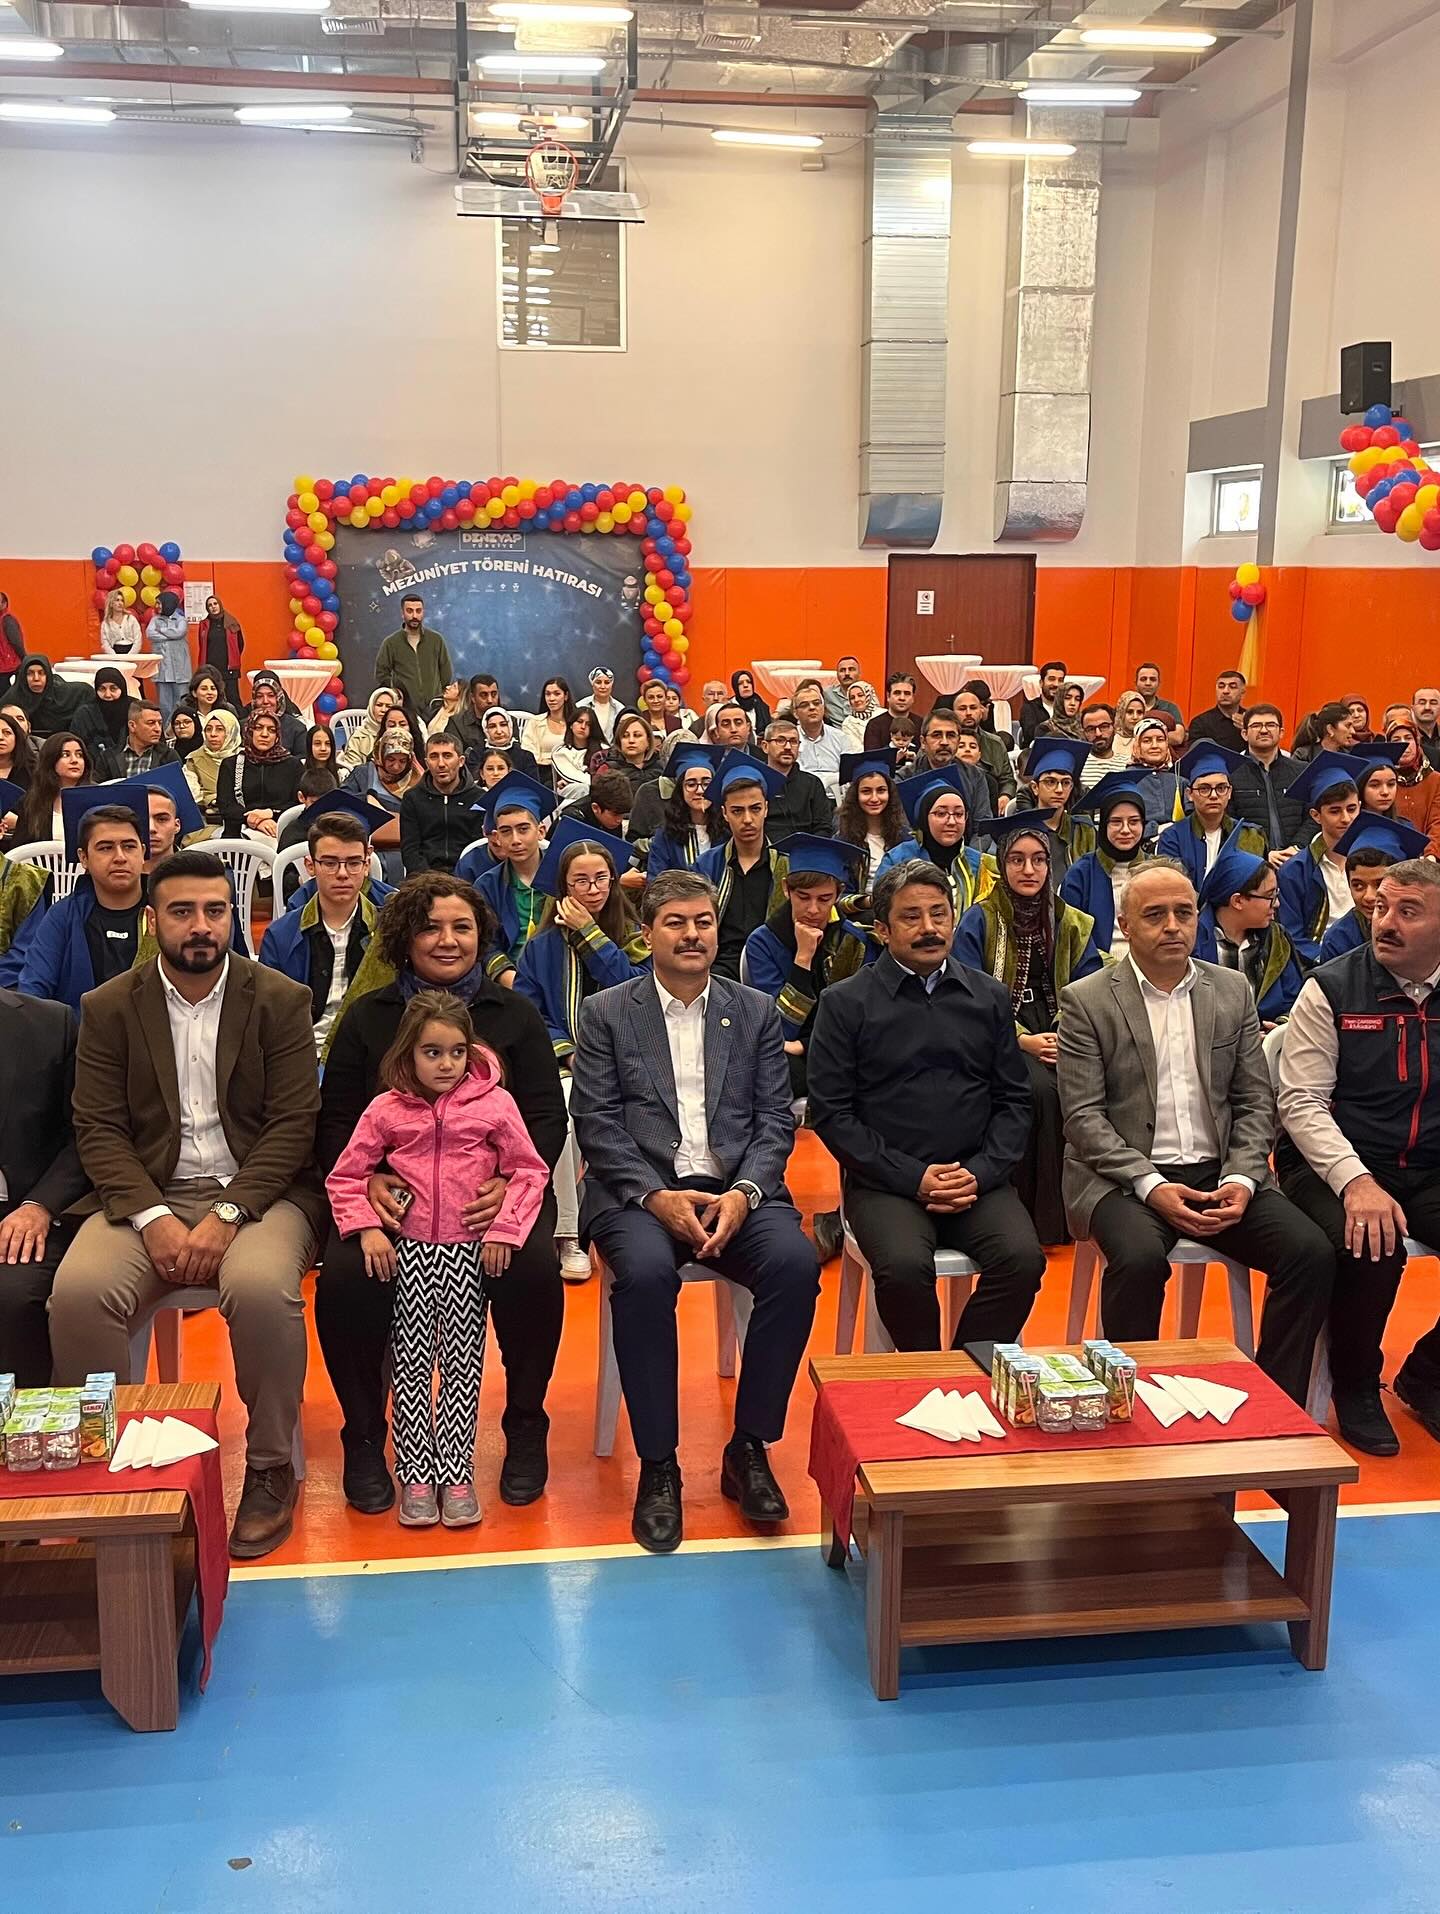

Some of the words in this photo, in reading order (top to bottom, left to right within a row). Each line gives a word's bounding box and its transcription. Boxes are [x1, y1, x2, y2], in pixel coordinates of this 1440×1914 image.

[462, 533, 522, 543] DENEYAP
[382, 561, 469, 597] MEZUNİYET
[472, 556, 529, 574] TÖRENİ
[532, 564, 603, 598] HATIRASI
